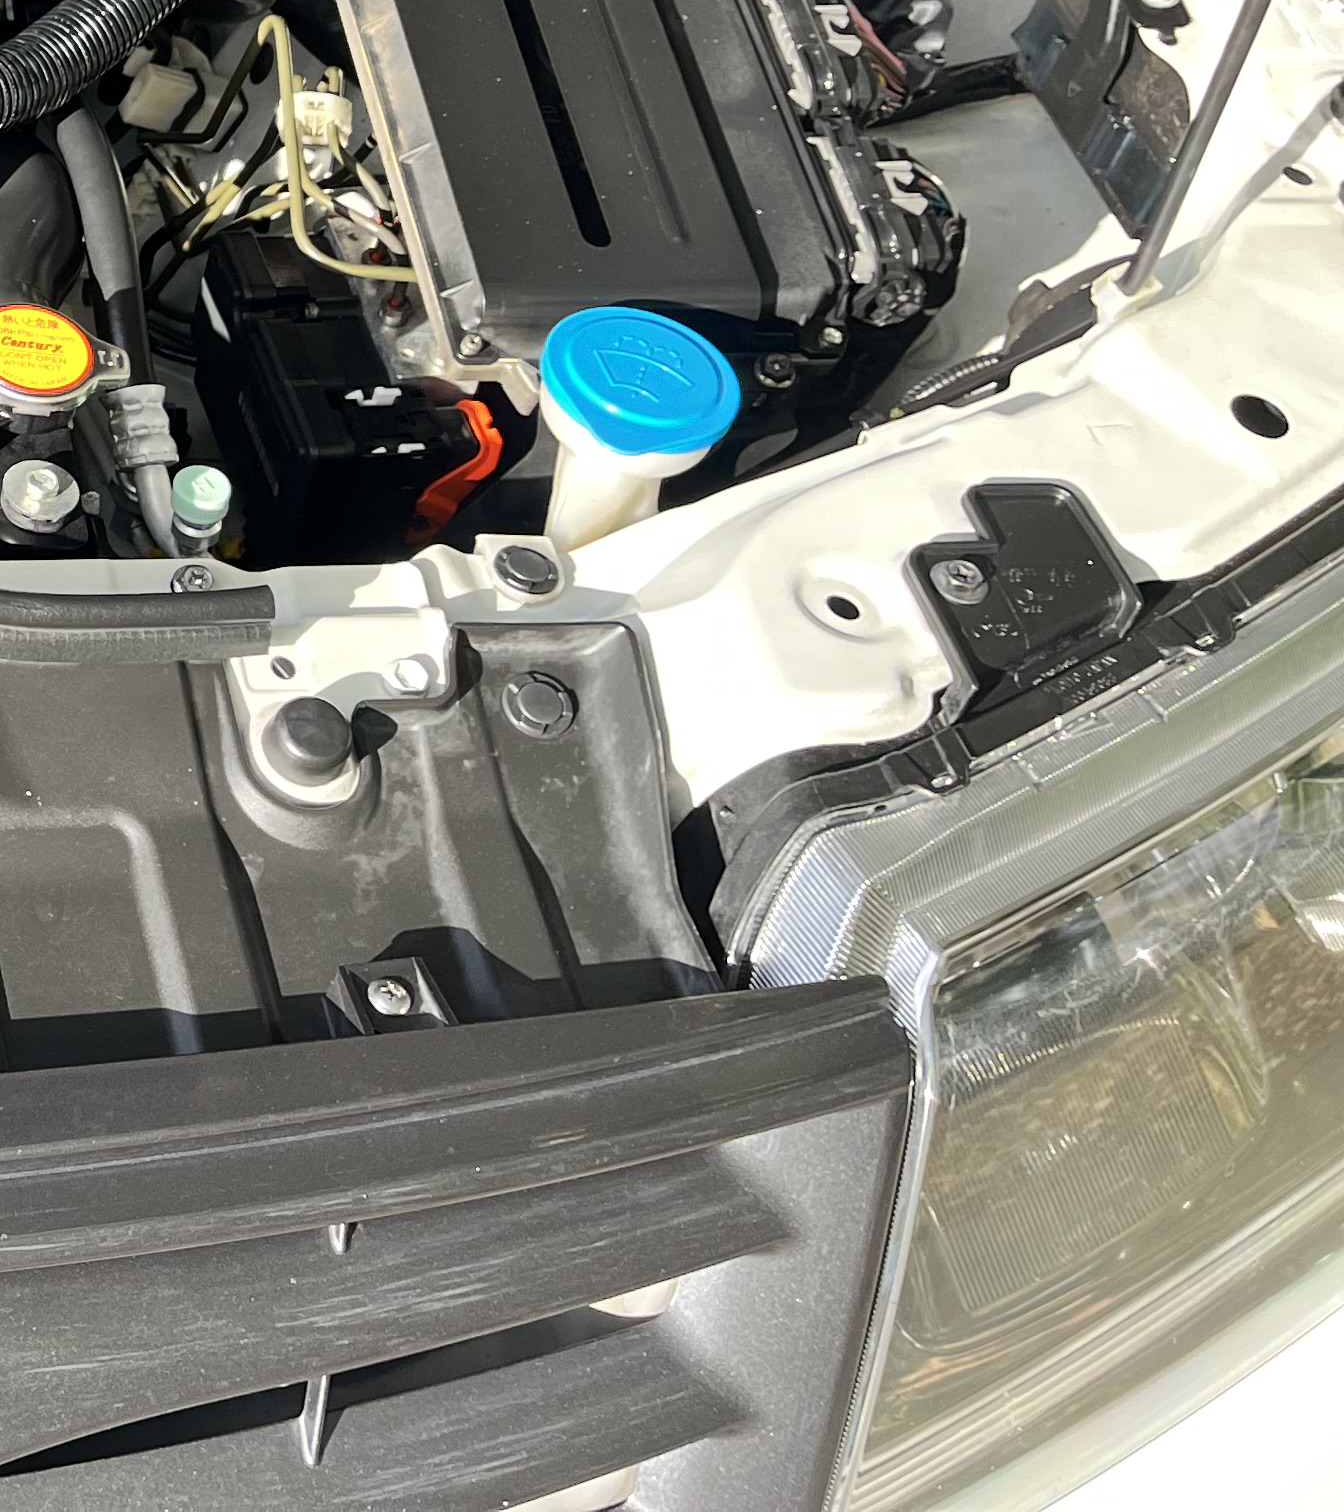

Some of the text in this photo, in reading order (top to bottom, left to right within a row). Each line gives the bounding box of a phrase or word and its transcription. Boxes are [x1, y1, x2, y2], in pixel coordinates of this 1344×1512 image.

[1, 336, 63, 353] Century
[36, 353, 67, 365] OPEN
[3, 360, 62, 371] WHEN HOT
